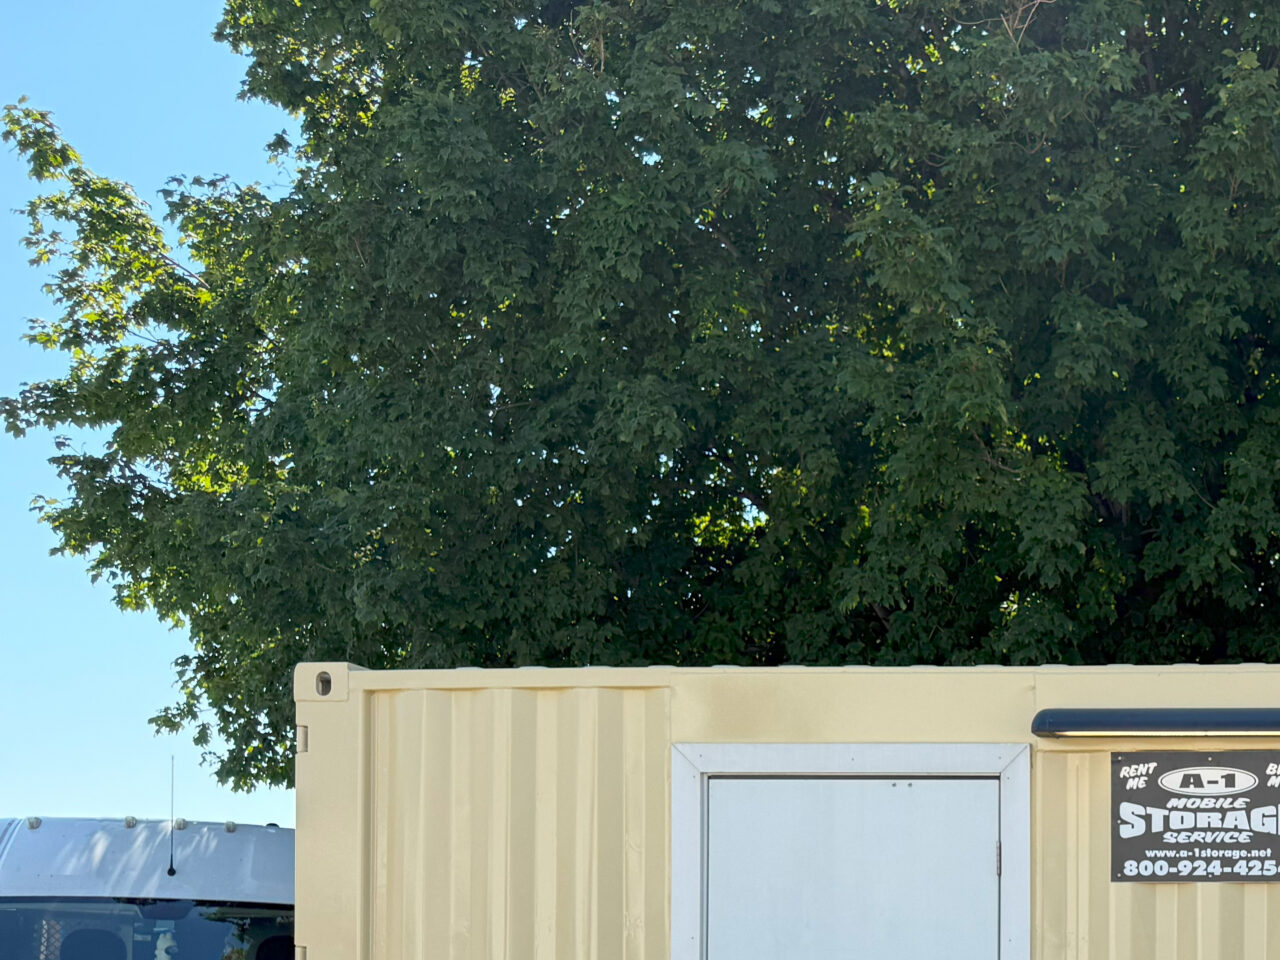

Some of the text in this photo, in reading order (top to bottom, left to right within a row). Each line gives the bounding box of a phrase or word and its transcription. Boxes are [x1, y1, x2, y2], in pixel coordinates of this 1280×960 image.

[1120, 762, 1157, 778] RENT
[1126, 776, 1149, 790] ME
[1179, 773, 1236, 788] A-1
[1166, 797, 1251, 809] MOBILE
[1162, 831, 1254, 843] SERVICE
[1145, 848, 1272, 860] www.a-1storage.net
